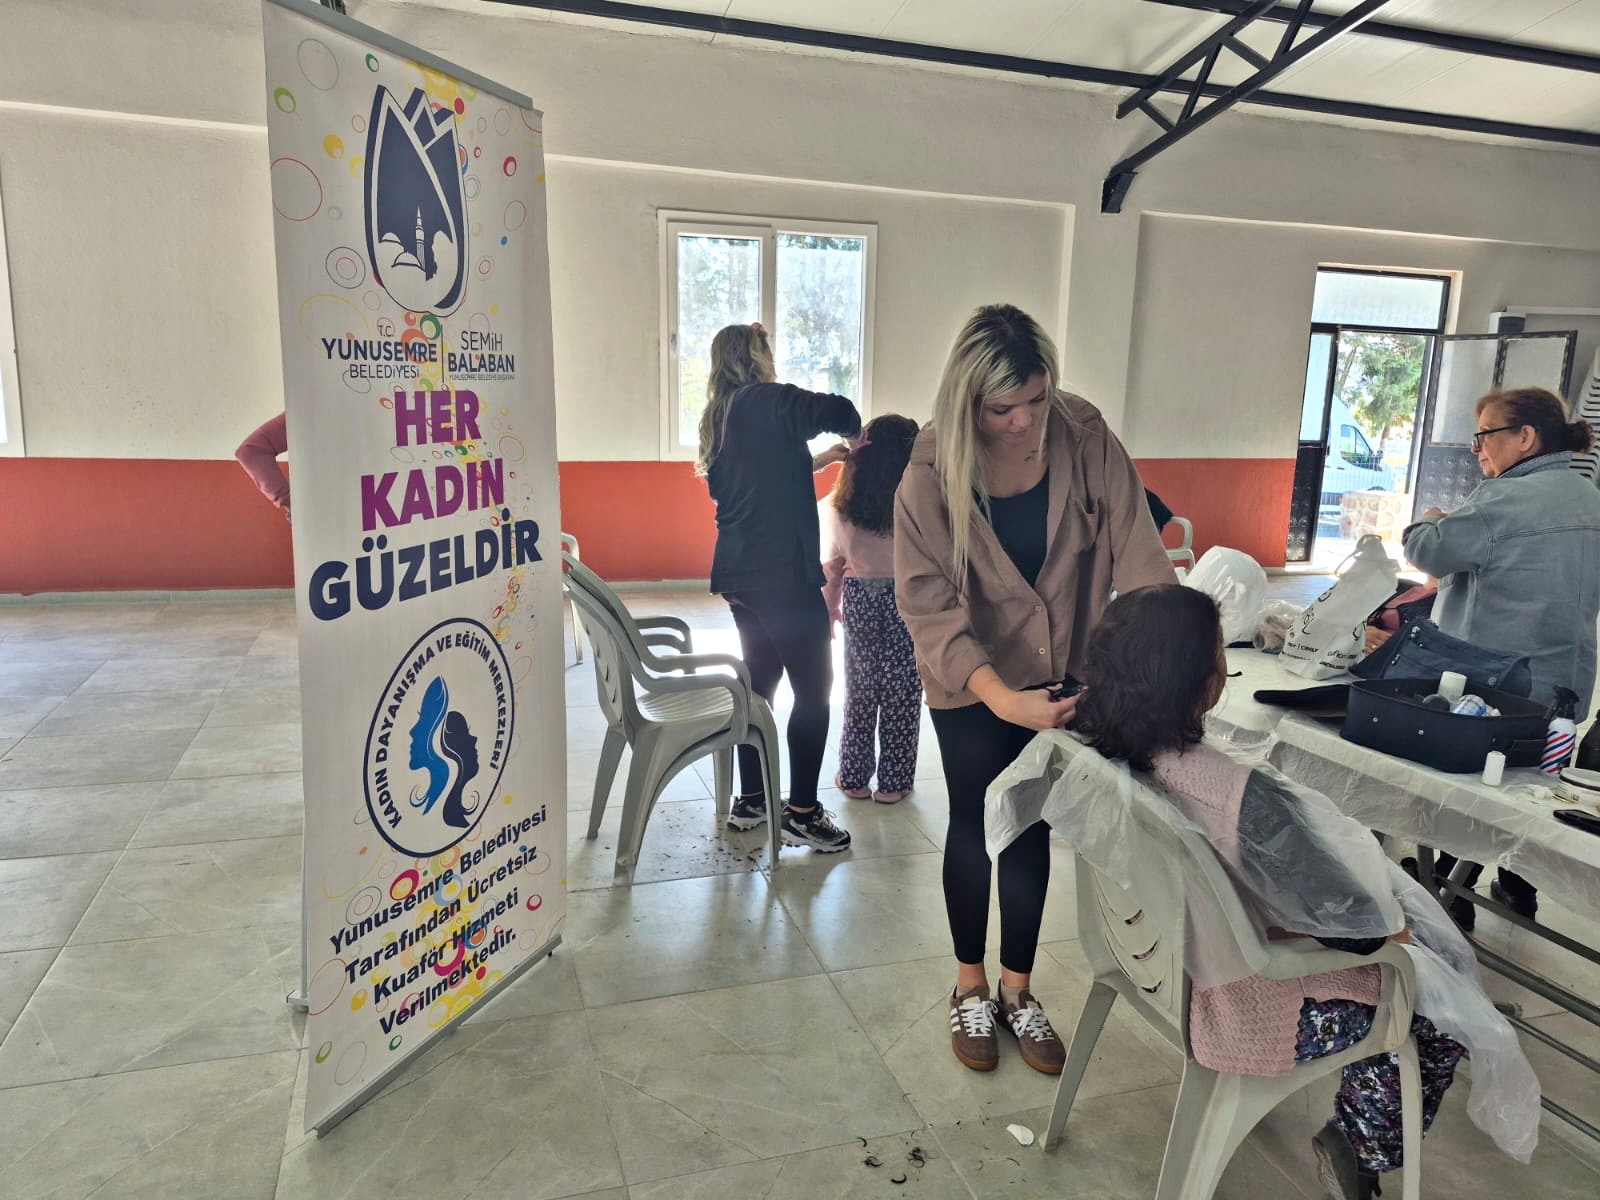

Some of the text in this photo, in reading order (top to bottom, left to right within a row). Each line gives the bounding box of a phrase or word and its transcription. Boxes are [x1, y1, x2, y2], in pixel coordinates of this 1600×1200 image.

[322, 337, 437, 362] YUNUSEMRE
[448, 352, 515, 373] BALABAN
[394, 389, 482, 447] HER
[360, 458, 505, 532] KADIN
[308, 507, 543, 622] GÜZELDİR
[436, 632, 453, 653] VE
[375, 646, 435, 763] DAYANIŞMA
[375, 767, 402, 829] KADIN
[329, 804, 547, 955] Yunusemre Belediyesi
[345, 845, 538, 984] Tarafından Ücretsiz
[374, 887, 519, 1004] Kuaför Hizmeti
[379, 926, 517, 1035] Verilmektedir.
